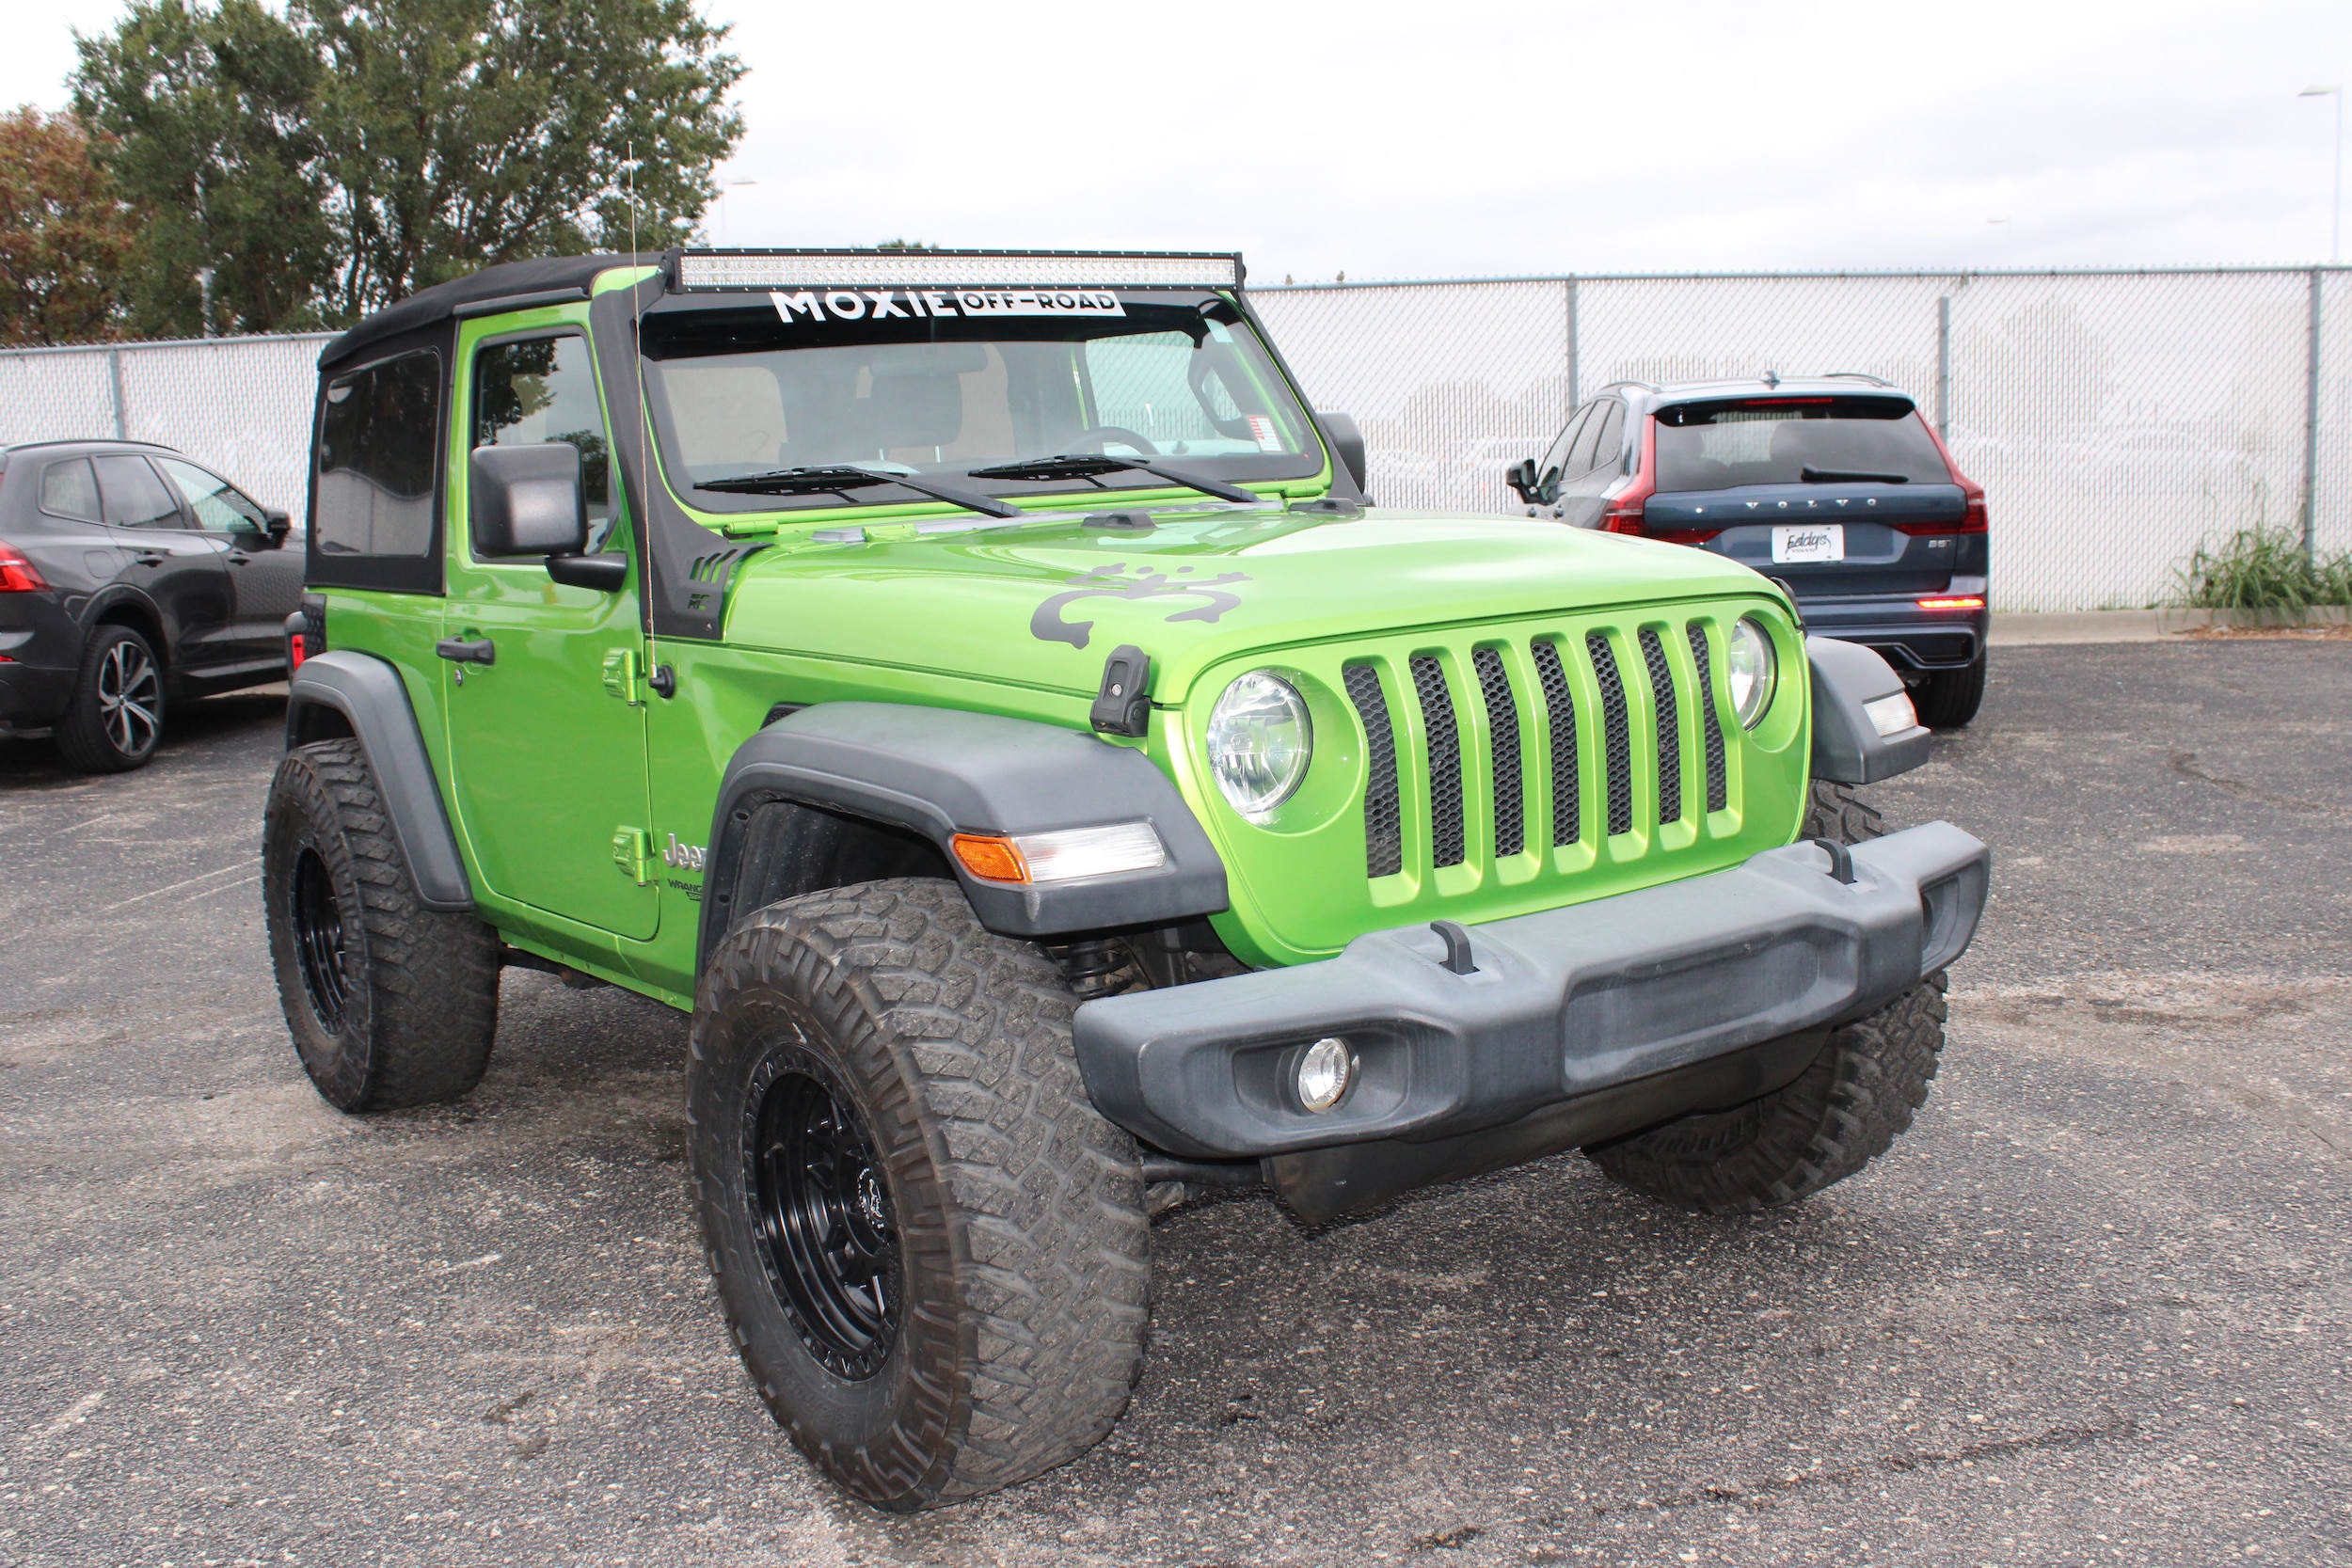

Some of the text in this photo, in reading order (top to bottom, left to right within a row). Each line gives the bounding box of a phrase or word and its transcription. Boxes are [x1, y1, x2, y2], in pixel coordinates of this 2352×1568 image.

[769, 291, 1116, 324] MOXIE OFF-ROAD
[1745, 498, 1877, 510] VOLVO
[1786, 531, 1829, 551] Eddy's
[668, 879, 704, 894] WRANG
